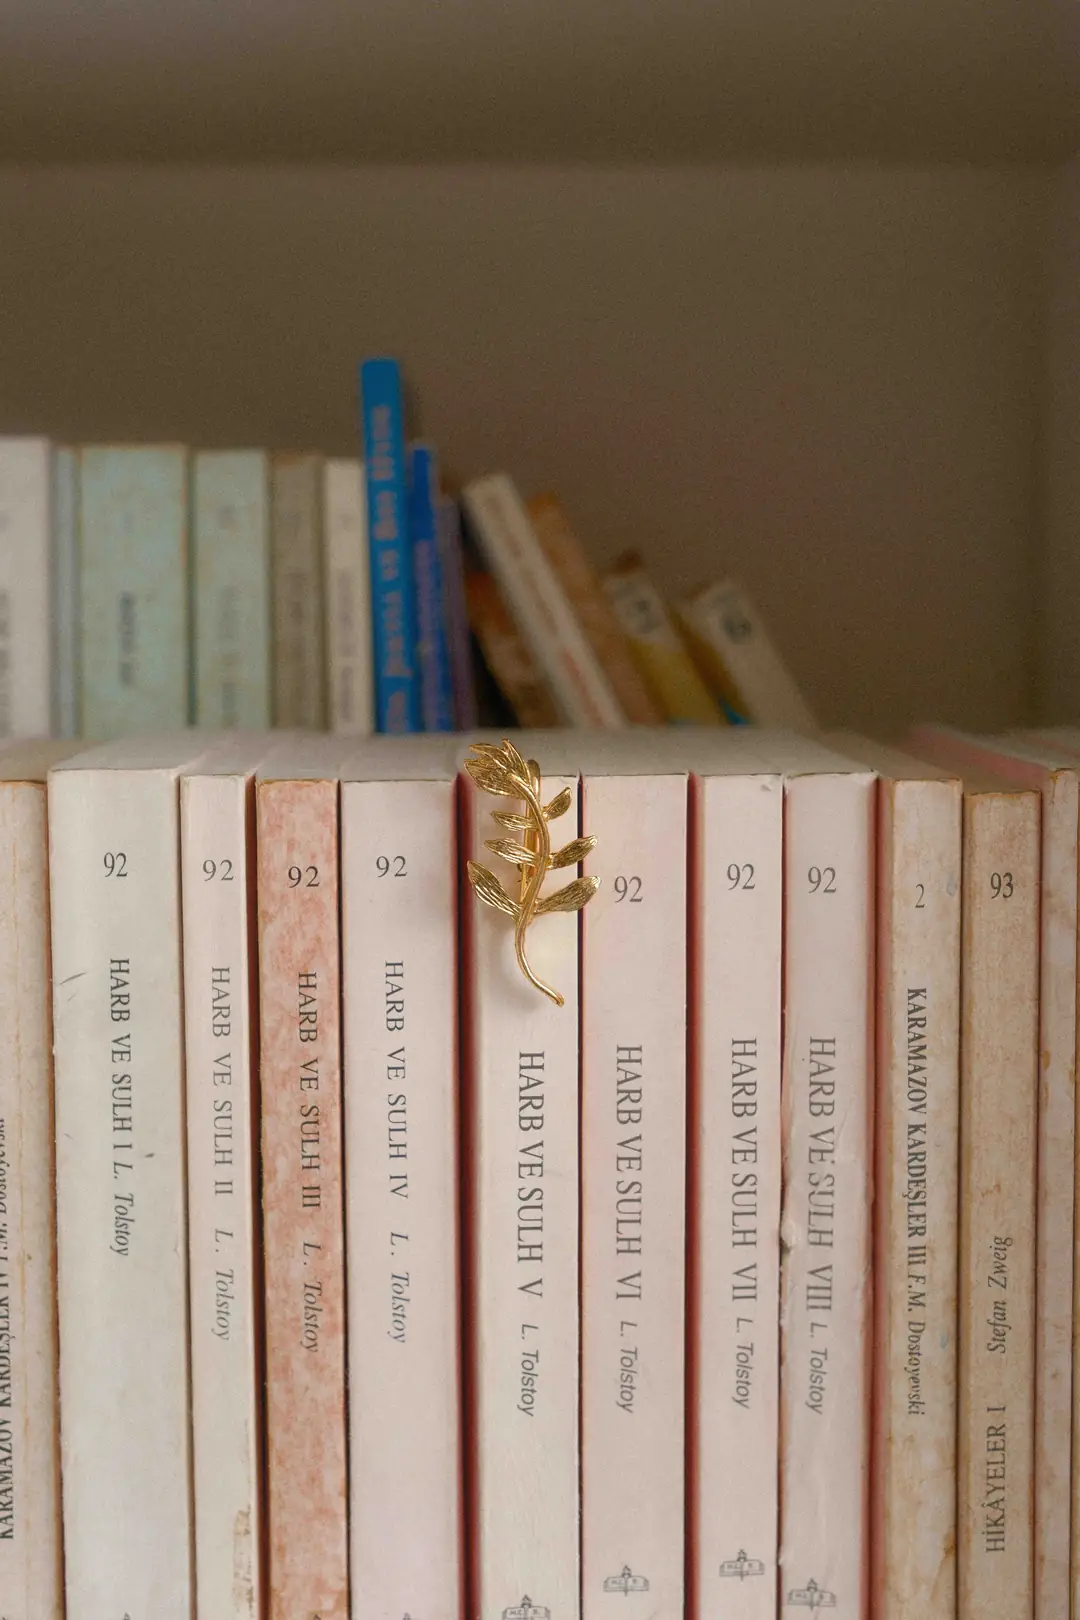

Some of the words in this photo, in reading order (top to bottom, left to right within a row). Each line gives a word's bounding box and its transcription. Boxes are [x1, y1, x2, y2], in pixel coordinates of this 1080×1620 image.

[104, 852, 128, 877] 92
[203, 859, 234, 881] 92
[287, 866, 320, 888] 92
[376, 856, 407, 878] 92
[727, 864, 755, 890] 92
[808, 867, 836, 893] 92
[614, 876, 643, 903] 92
[915, 884, 925, 908] 2
[991, 872, 1014, 901] 93
[110, 958, 130, 1022] HARB
[212, 967, 231, 1037] HARB
[298, 971, 319, 1044] HARB
[385, 961, 404, 1032] HARB
[111, 1033, 131, 1063] VE
[387, 1046, 405, 1080] VE
[907, 988, 927, 1115] KARAMAZOV
[213, 1052, 231, 1086] VE
[300, 1056, 319, 1092] VE
[616, 1044, 643, 1125] HARB
[732, 1038, 757, 1118] HARB
[809, 1037, 836, 1117] HARB
[112, 1074, 132, 1132] SULH
[518, 1051, 545, 1131] HARB
[213, 1100, 233, 1166] SULH
[300, 1103, 321, 1171] SULH
[388, 1094, 407, 1159] SULH
[732, 1126, 757, 1164] VE
[808, 1126, 835, 1164] VE
[113, 1161, 133, 1179] L.
[518, 1140, 544, 1179] VE
[616, 1134, 642, 1173] VE
[215, 1180, 233, 1195] II
[302, 1184, 321, 1210] III
[389, 1173, 408, 1199] IV
[902, 1122, 928, 1238] KARDEŞLER
[110, 1193, 135, 1256] Tolstoy
[517, 1186, 544, 1263] SULH
[616, 1180, 642, 1255] SULH
[732, 1173, 758, 1248] SULH
[807, 1173, 835, 1248] SULH
[215, 1229, 233, 1252] L.
[303, 1241, 322, 1266] L.
[390, 1232, 409, 1255] L.
[907, 1244, 926, 1266] III
[732, 1263, 757, 1301] VII
[988, 1236, 1013, 1290] Zweig
[211, 1269, 235, 1340] Tolstoy
[517, 1278, 543, 1298] V
[616, 1270, 642, 1300] VI
[806, 1264, 833, 1310] VIII
[300, 1281, 323, 1352] Tolstoy
[387, 1272, 410, 1343] Tolstoy
[737, 1317, 753, 1333] L.
[987, 1300, 1012, 1354] Stefan
[522, 1324, 539, 1340] L.
[621, 1321, 637, 1336] L.
[810, 1322, 827, 1337] L.
[517, 1349, 539, 1417] Tolstoy
[616, 1347, 638, 1413] Tolstoy
[732, 1343, 754, 1409] Tolstoy
[805, 1348, 827, 1414] Tolstoy
[904, 1321, 926, 1415] Dostoyevski
[981, 1424, 1006, 1552] HİKÂYELER
